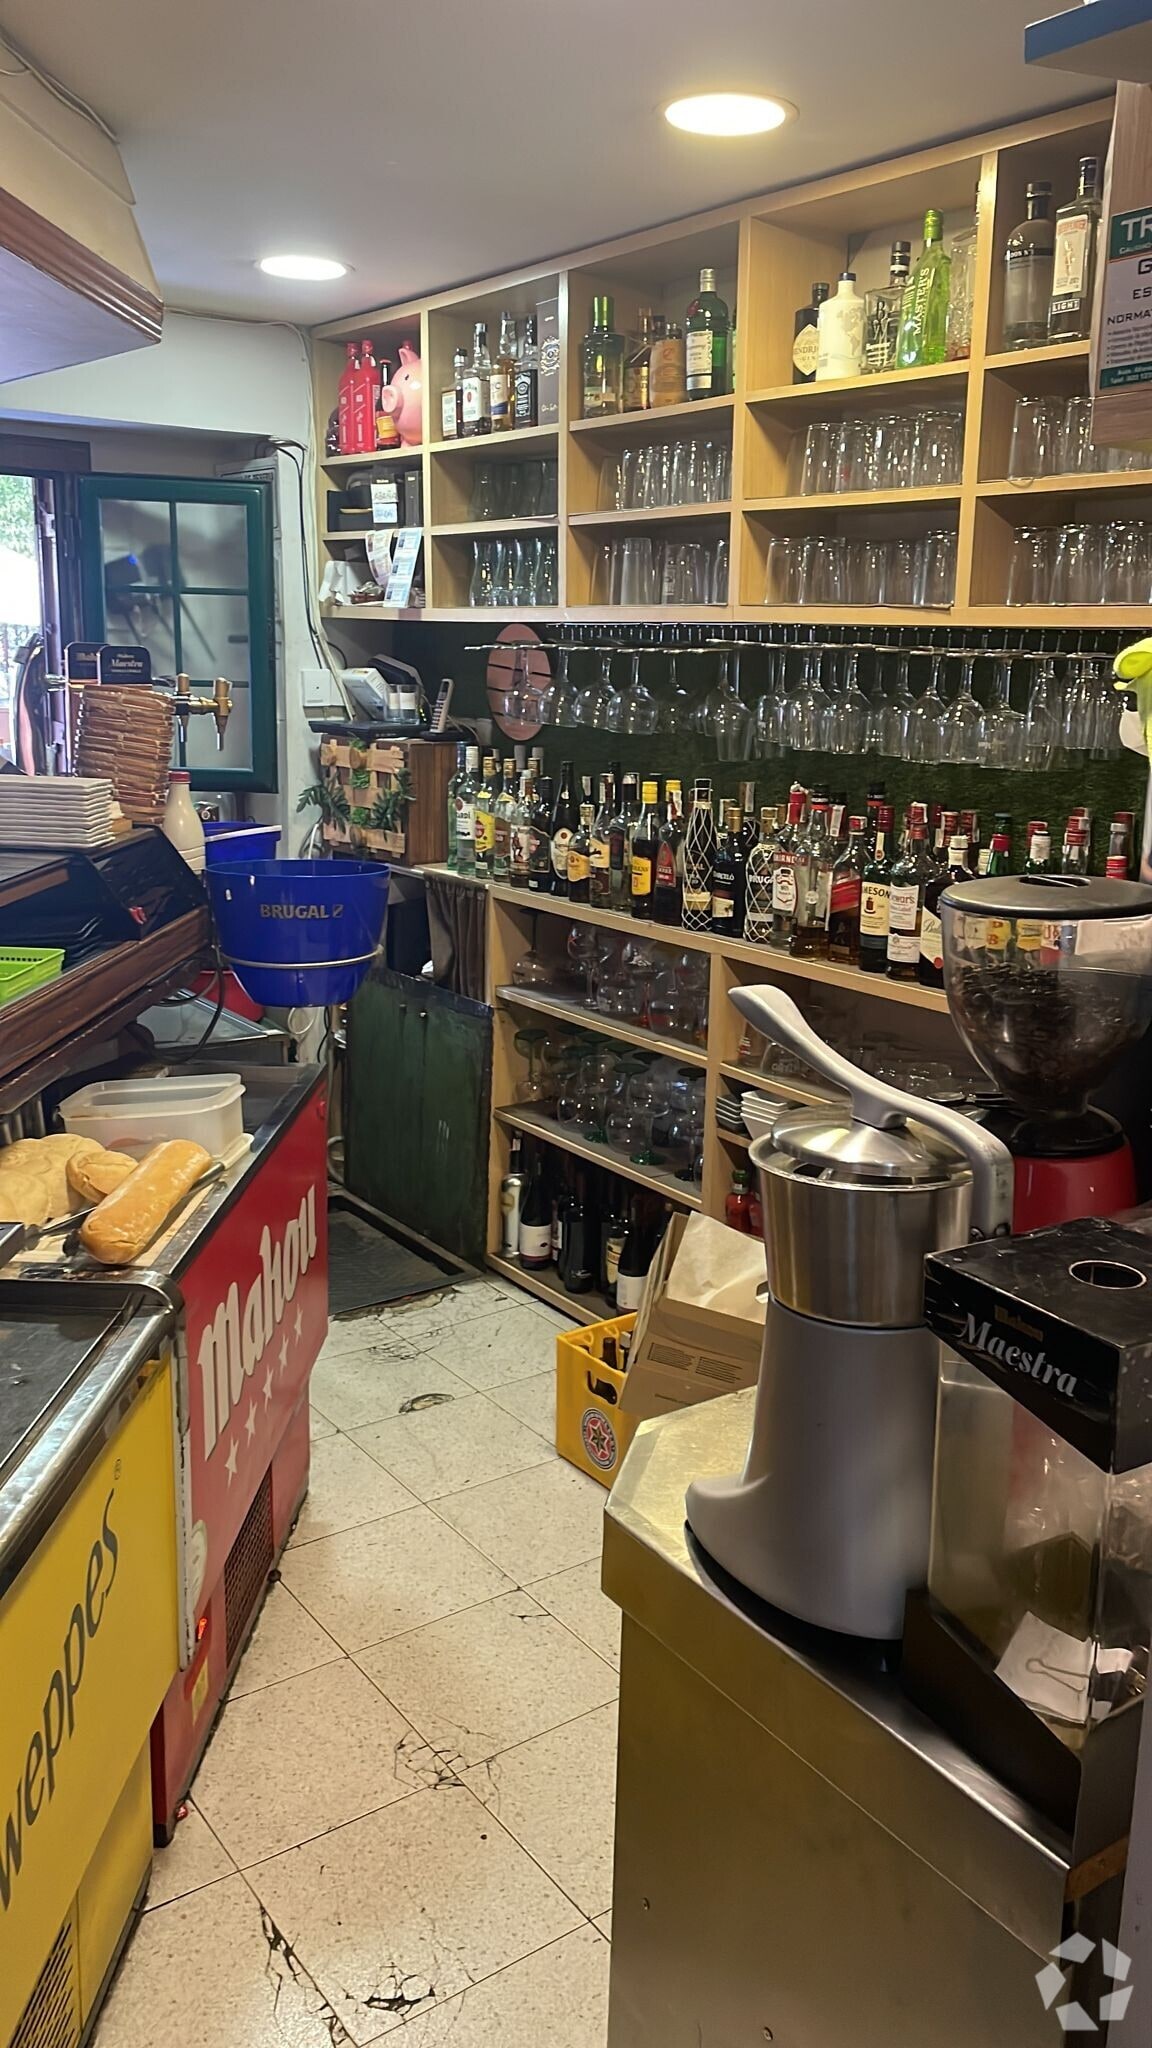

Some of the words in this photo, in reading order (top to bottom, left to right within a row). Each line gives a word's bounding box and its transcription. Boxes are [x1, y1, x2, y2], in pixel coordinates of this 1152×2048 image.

[913, 267, 930, 336] MASTER'S
[1052, 300, 1080, 312] LIGHT
[1107, 308, 1152, 325] NORMA
[260, 904, 330, 919] BRUGAL
[954, 1312, 1078, 1398] Maestra
